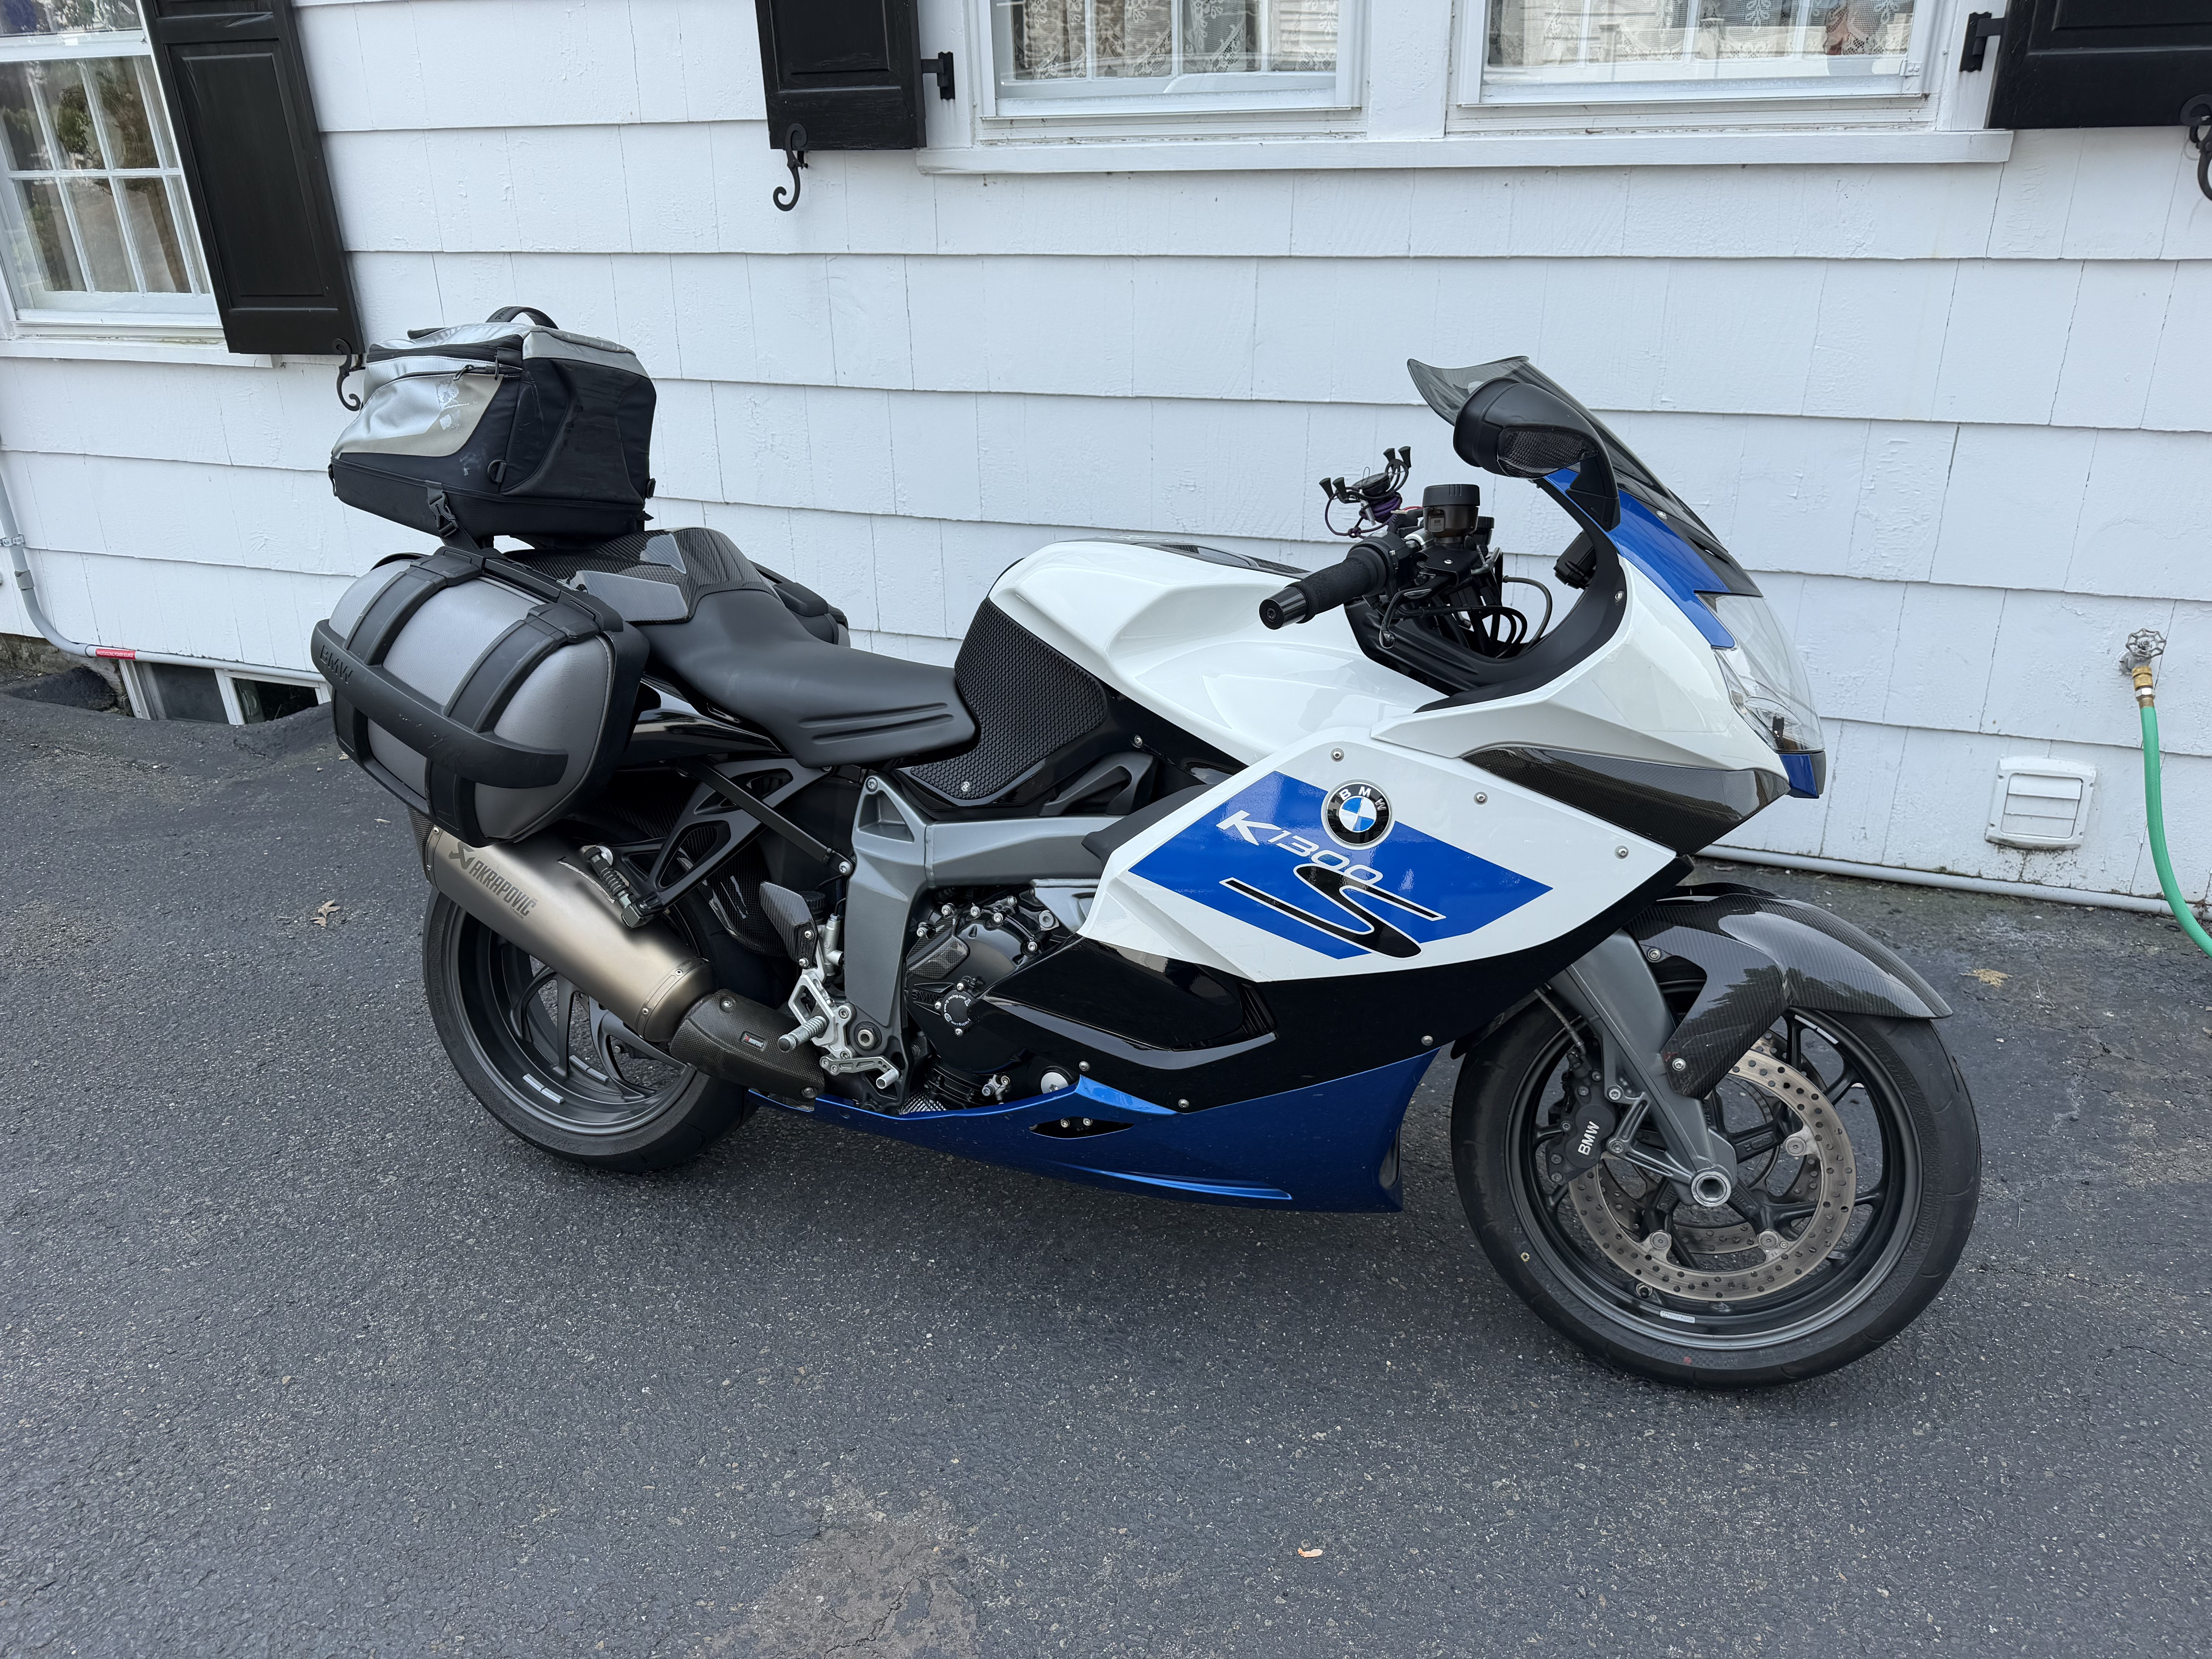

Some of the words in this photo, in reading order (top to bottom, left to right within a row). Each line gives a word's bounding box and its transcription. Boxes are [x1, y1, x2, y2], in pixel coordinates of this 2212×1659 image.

[320, 645, 353, 684] BMW
[1339, 786, 1387, 811] BMW
[1219, 863, 1446, 960] S
[912, 989, 940, 1003] BMW
[1578, 1121, 1599, 1156] BMW
